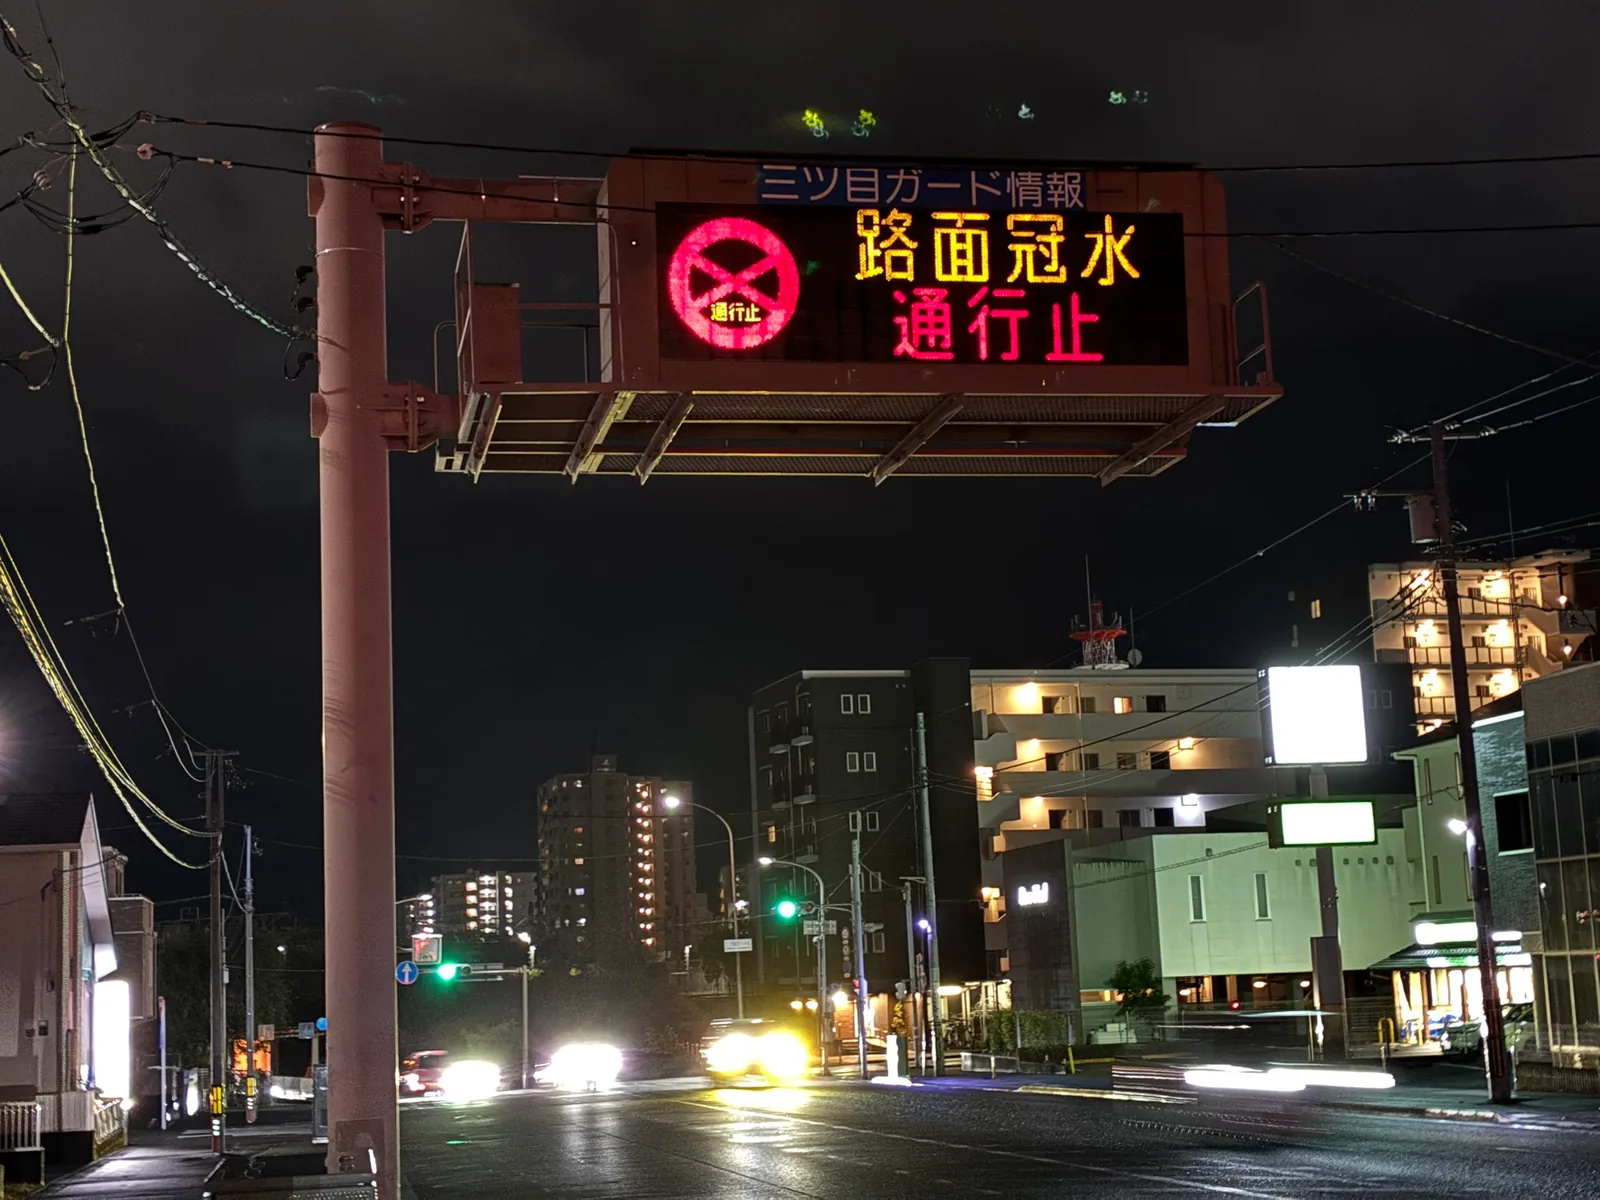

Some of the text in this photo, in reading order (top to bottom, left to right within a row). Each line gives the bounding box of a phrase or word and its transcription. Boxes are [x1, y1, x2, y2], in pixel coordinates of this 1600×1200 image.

[761, 164, 1085, 209] 三ツ目ガード情報
[855, 208, 1140, 286] 路面冠水
[711, 302, 761, 322] 通行止
[893, 286, 1104, 361] 通行止
